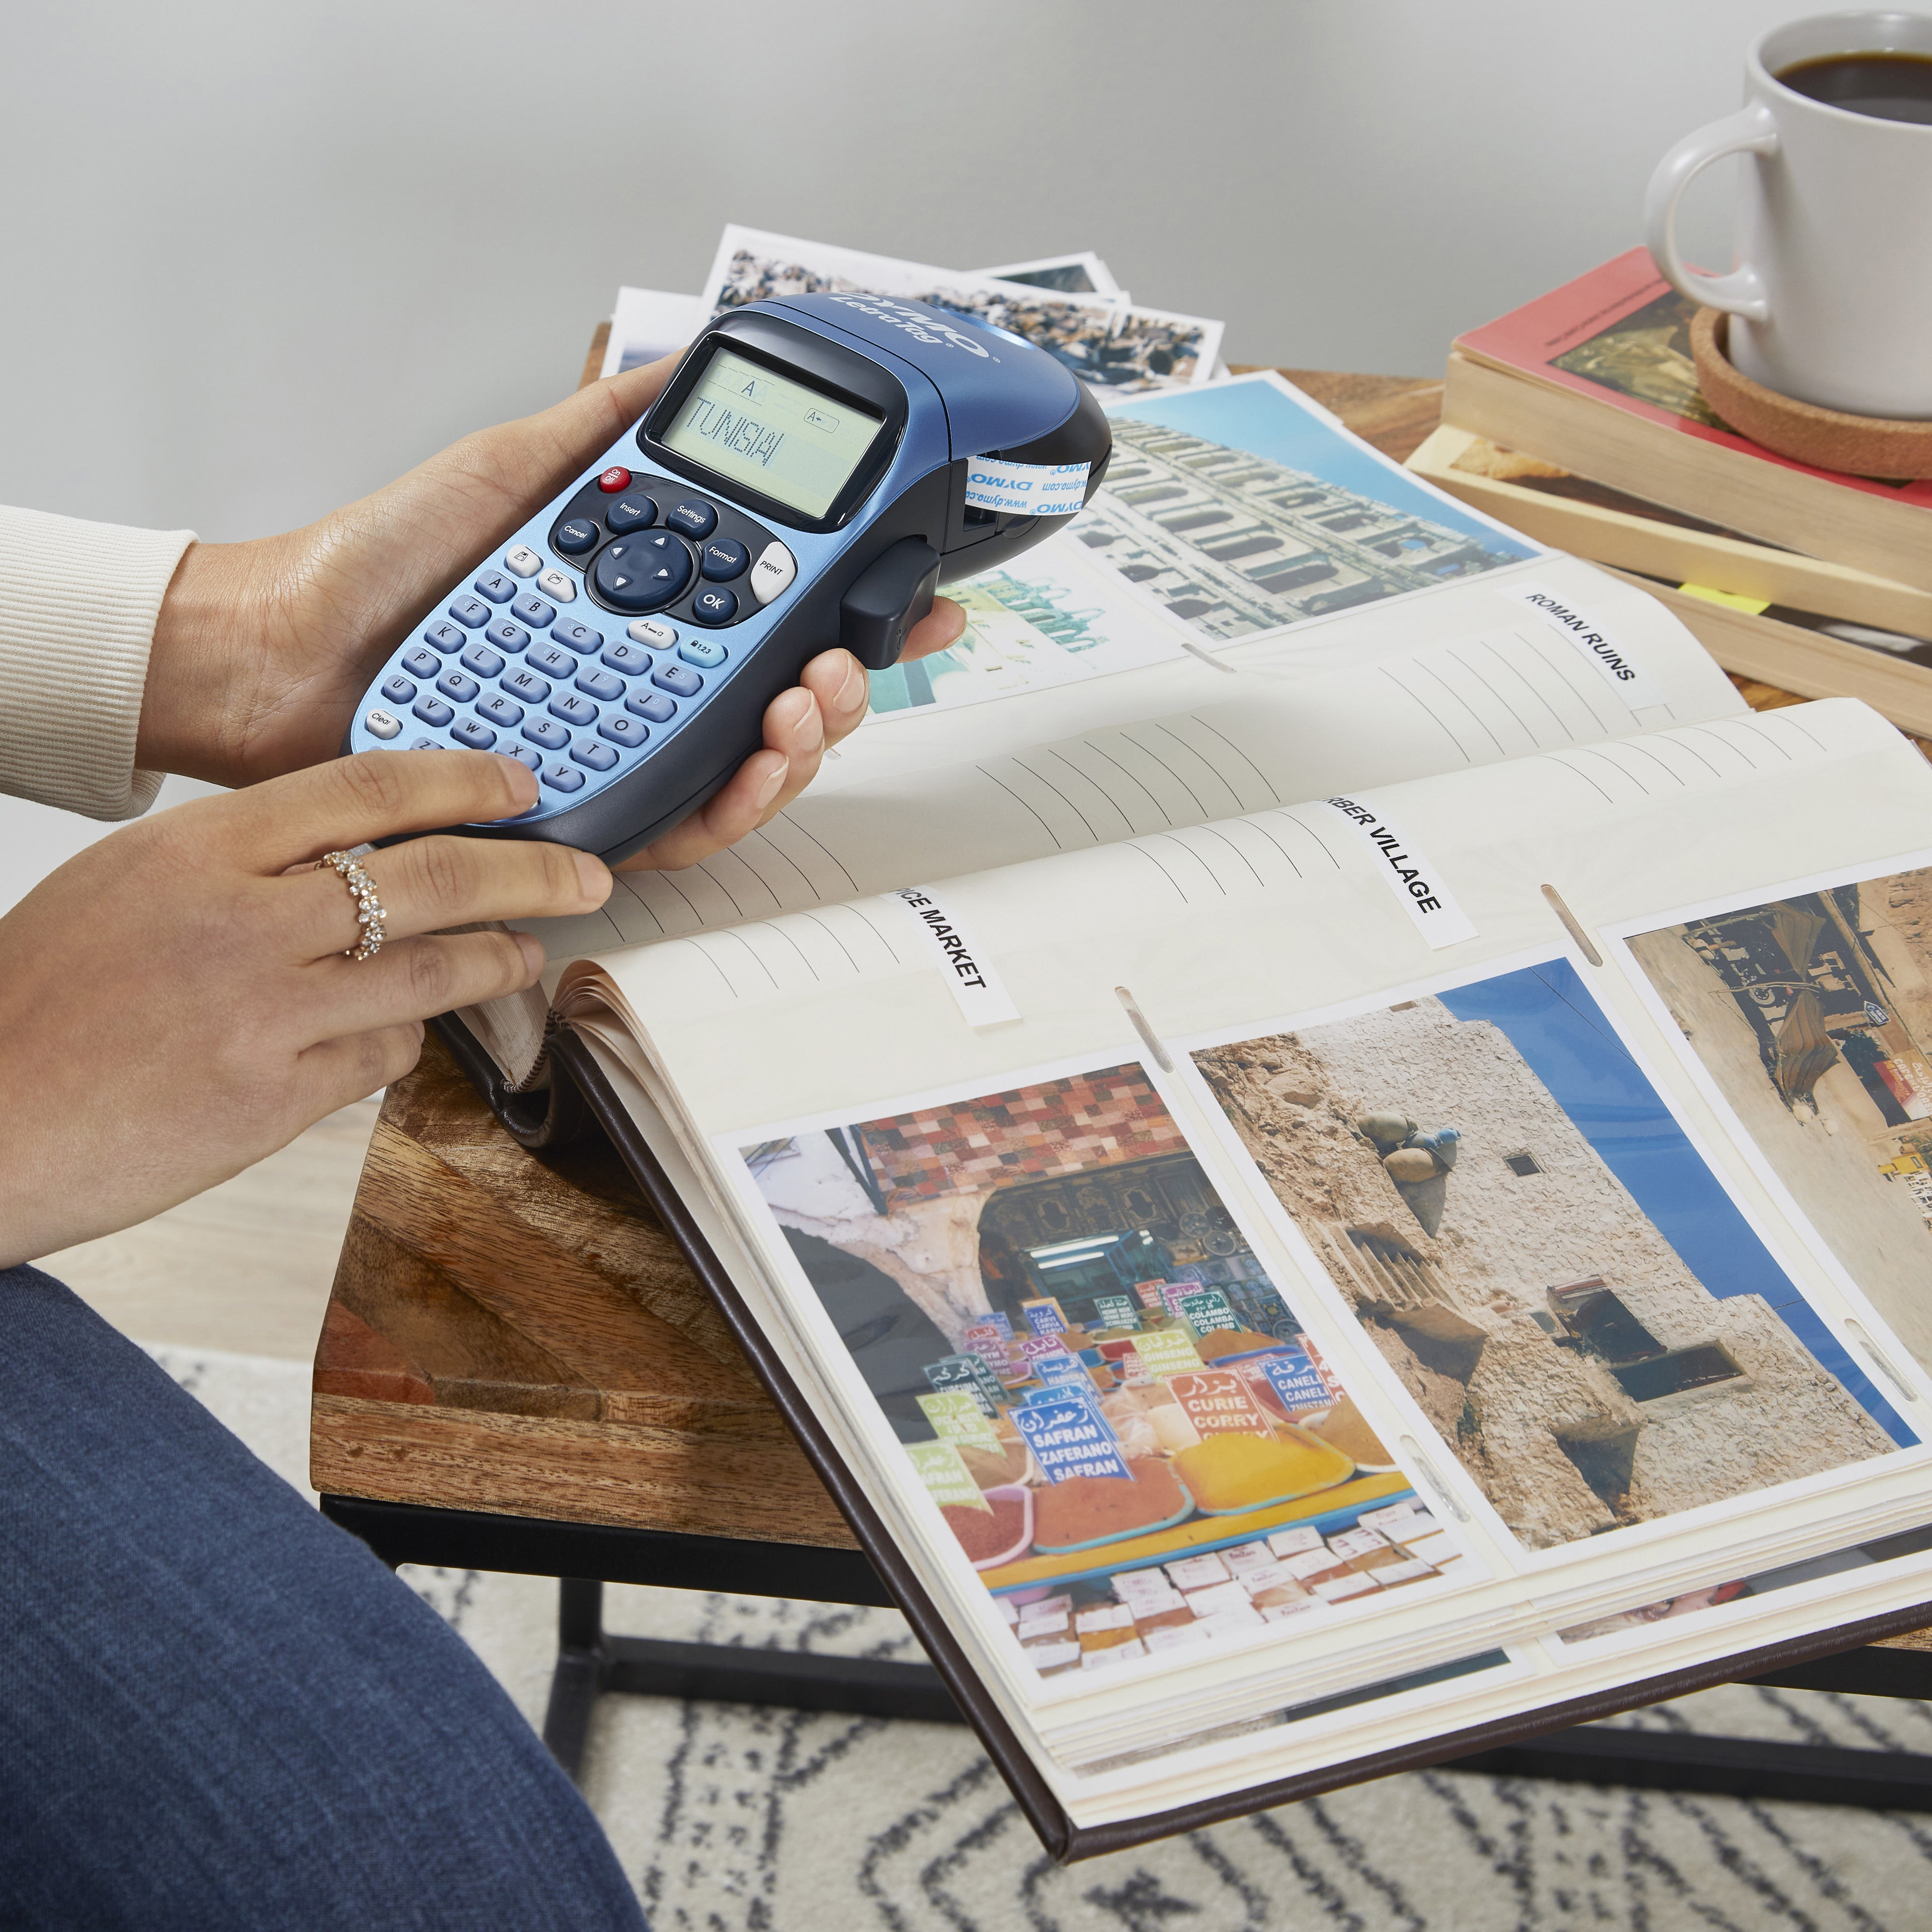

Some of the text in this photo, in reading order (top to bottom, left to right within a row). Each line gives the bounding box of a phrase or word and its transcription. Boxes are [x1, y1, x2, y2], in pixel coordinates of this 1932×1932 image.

[836, 292, 989, 357] DYMO
[741, 381, 755, 396] A
[1057, 463, 1090, 473] YMO
[971, 473, 1087, 492] w.dymo.com DYMO
[966, 491, 1083, 514] DYMO www.dymo.co
[620, 503, 641, 516] Insert
[677, 505, 706, 524] Settings
[565, 526, 588, 539] Cancel
[709, 546, 737, 564] Format
[760, 560, 783, 576] PRINT
[489, 578, 502, 588] A
[529, 602, 540, 612] B
[703, 594, 725, 609] OK
[466, 604, 478, 612] F
[438, 626, 451, 637] K
[502, 627, 515, 636] G
[572, 627, 586, 637] C
[1525, 594, 1635, 681] ROMAN RUINS
[414, 653, 426, 661] P
[474, 650, 484, 661] L
[614, 646, 628, 657] D
[546, 652, 560, 664] H
[665, 667, 679, 678] E
[392, 679, 405, 688] U
[449, 676, 462, 687] Q
[514, 674, 532, 687] M
[427, 700, 438, 709] V
[491, 698, 504, 709] R
[564, 697, 580, 709] N
[639, 695, 653, 704] J
[371, 713, 391, 726] Clear
[466, 722, 480, 733] W
[538, 722, 550, 733] S
[419, 741, 431, 750] Z
[509, 746, 524, 757] X
[587, 744, 599, 755] T
[555, 767, 569, 777] Y
[1319, 797, 1441, 914] RBER VILLAGE
[888, 888, 987, 988] PICE MARKET
[1034, 1316, 1056, 1324] CARVI
[1189, 1308, 1229, 1320] COLAMBO
[1194, 1315, 1235, 1327] COLAMBA
[1144, 1347, 1194, 1362] GINSENG
[1150, 1358, 1200, 1373] GINSENG
[1188, 1396, 1248, 1412] CURIE
[1193, 1413, 1258, 1428] CORRY
[1033, 1424, 1098, 1448] SAFRAN
[1039, 1441, 1112, 1466] ZAFERANO
[1053, 1459, 1119, 1482] SAFRAN
[921, 1469, 964, 1486] AFRAN
